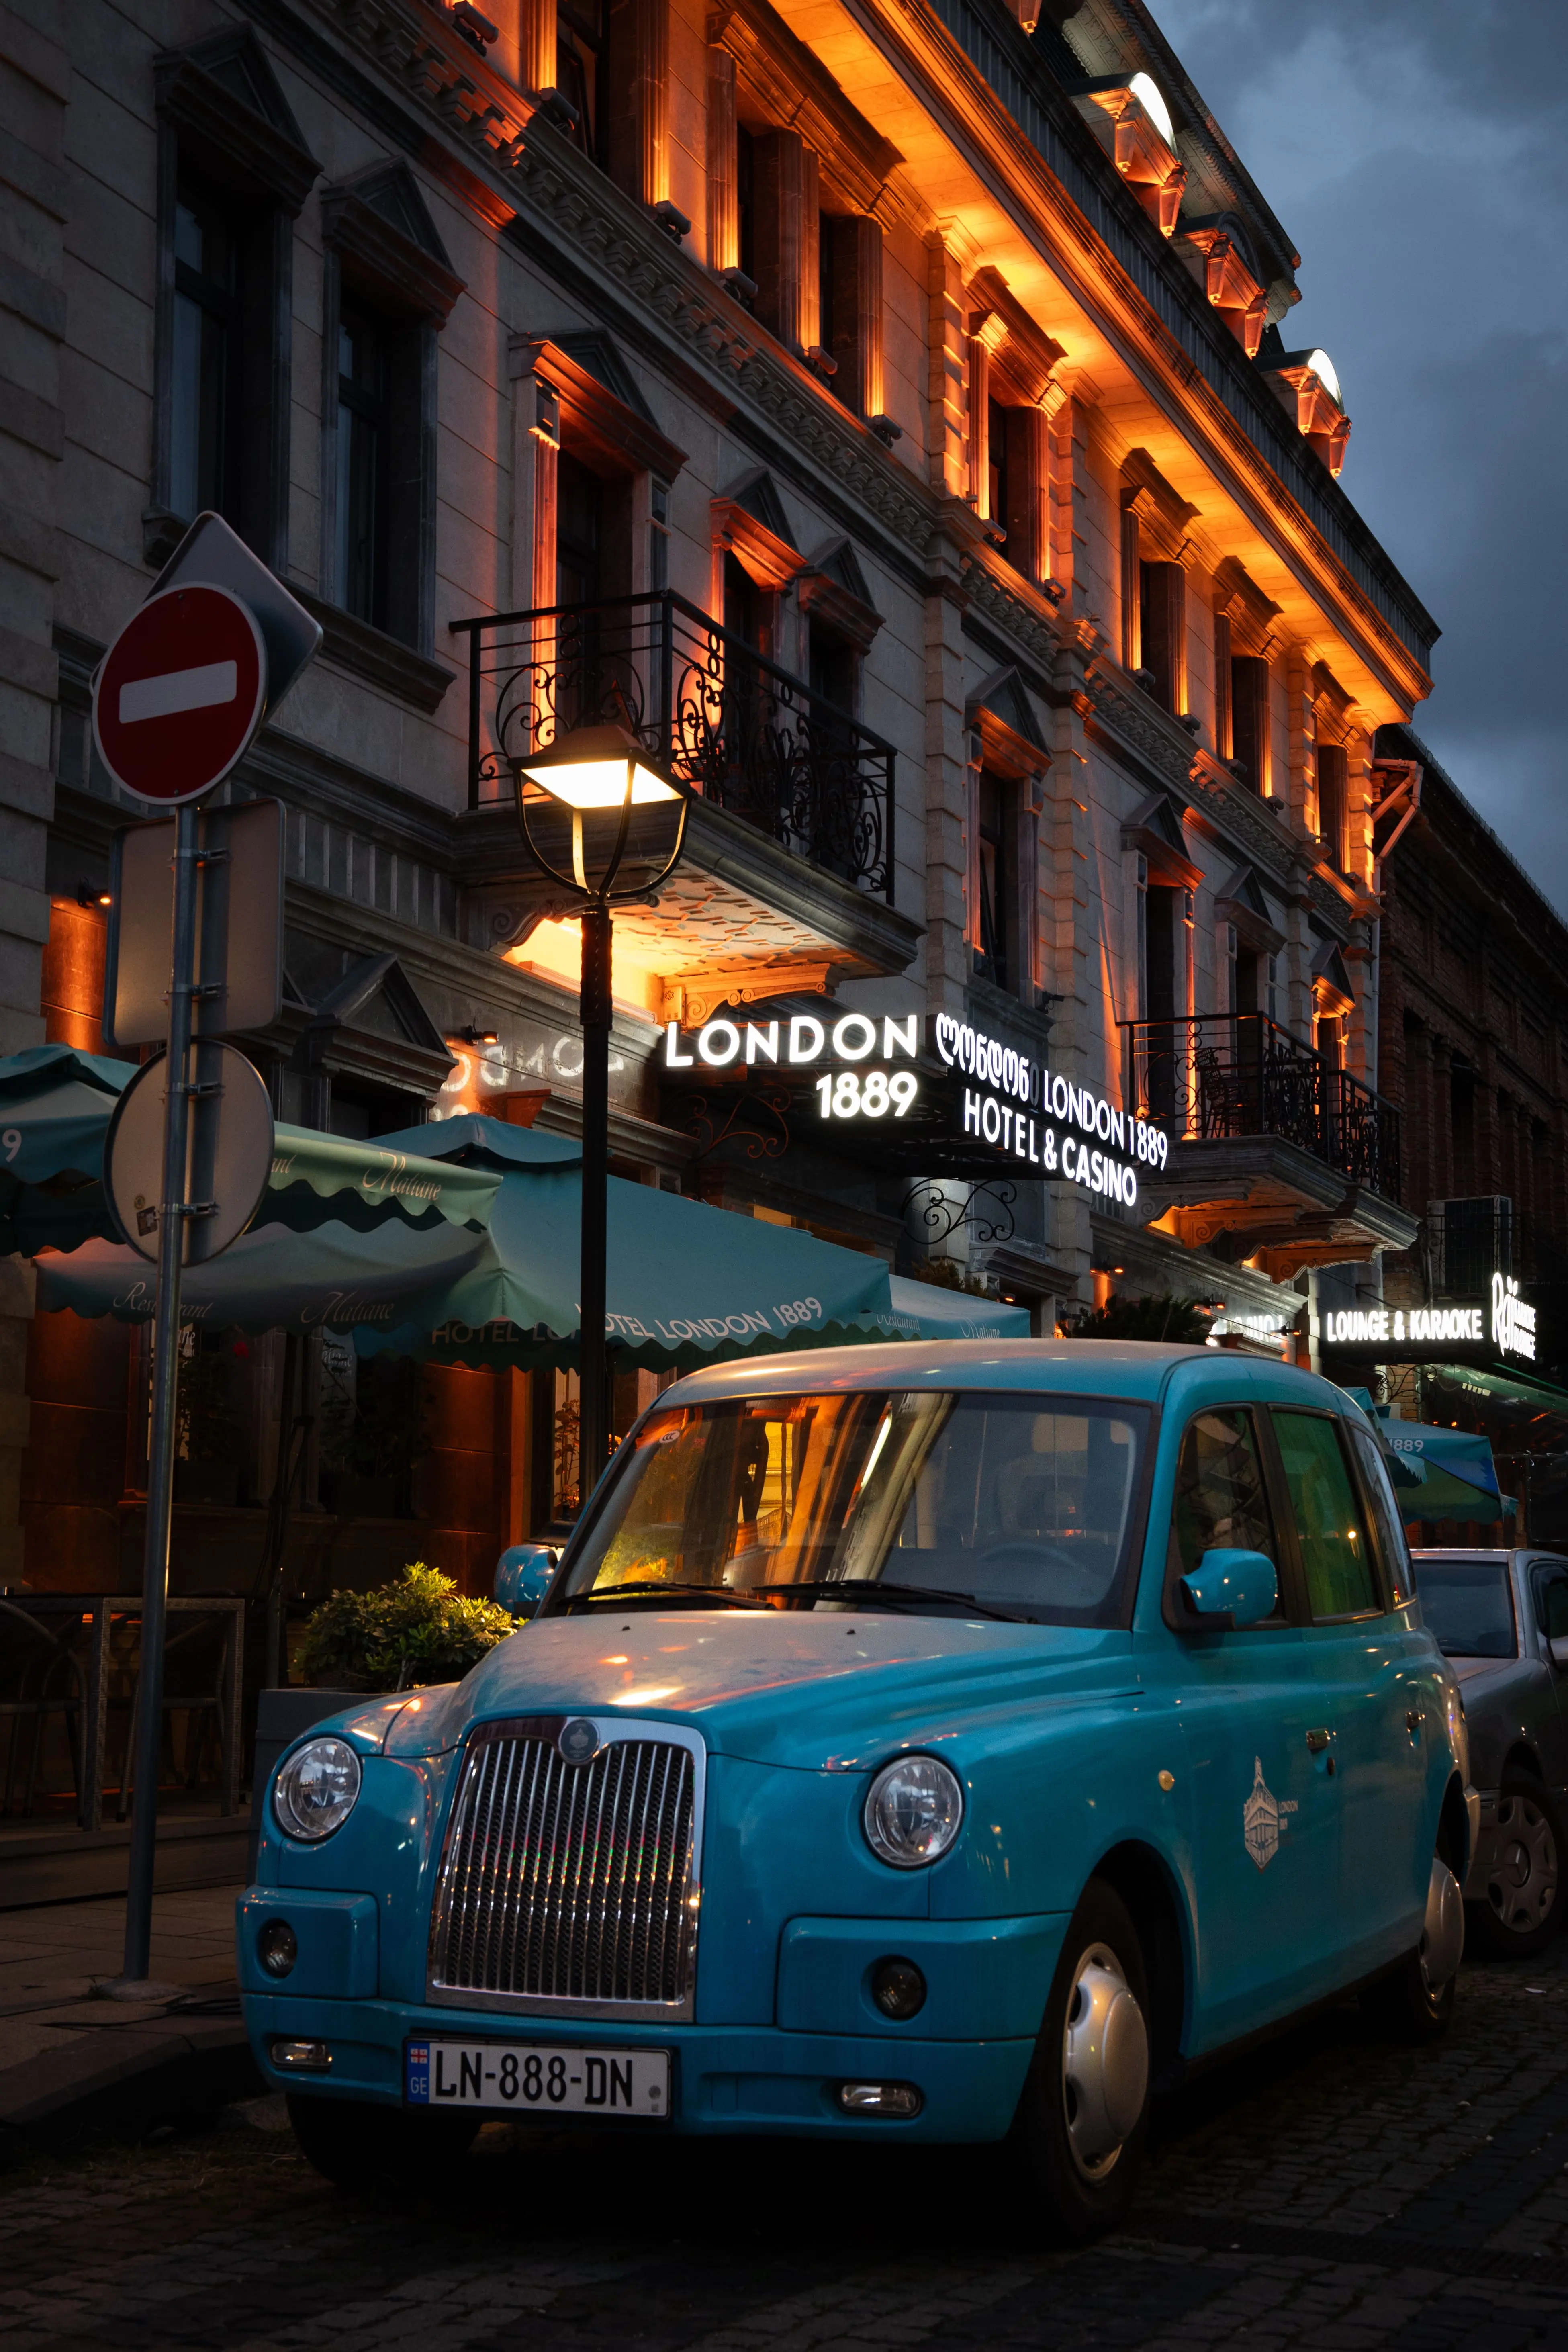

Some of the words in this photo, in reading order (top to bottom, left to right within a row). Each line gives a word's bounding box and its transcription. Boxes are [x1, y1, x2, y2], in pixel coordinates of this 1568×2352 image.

[666, 1014, 917, 1067] LONDON
[816, 1072, 918, 1118] 1889
[1044, 1070, 1124, 1151] LONDON
[1128, 1115, 1168, 1171] 1889
[965, 1088, 1039, 1163] HOTEL
[1044, 1129, 1057, 1170] &
[1062, 1137, 1137, 1207] CASINO
[362, 1152, 442, 1201] Matiane
[301, 1289, 395, 1323] Matiane
[655, 1311, 772, 1338] LONDON
[773, 1297, 822, 1327] 1889
[1327, 1311, 1389, 1341] LOUNGE
[1394, 1310, 1405, 1341] &
[1410, 1309, 1483, 1340] KARAOKE
[431, 1321, 519, 1345] HOTEL
[960, 1317, 1000, 1339] Matiane
[411, 2077, 427, 2095] GE
[435, 2050, 633, 2107] LN-888-DN
